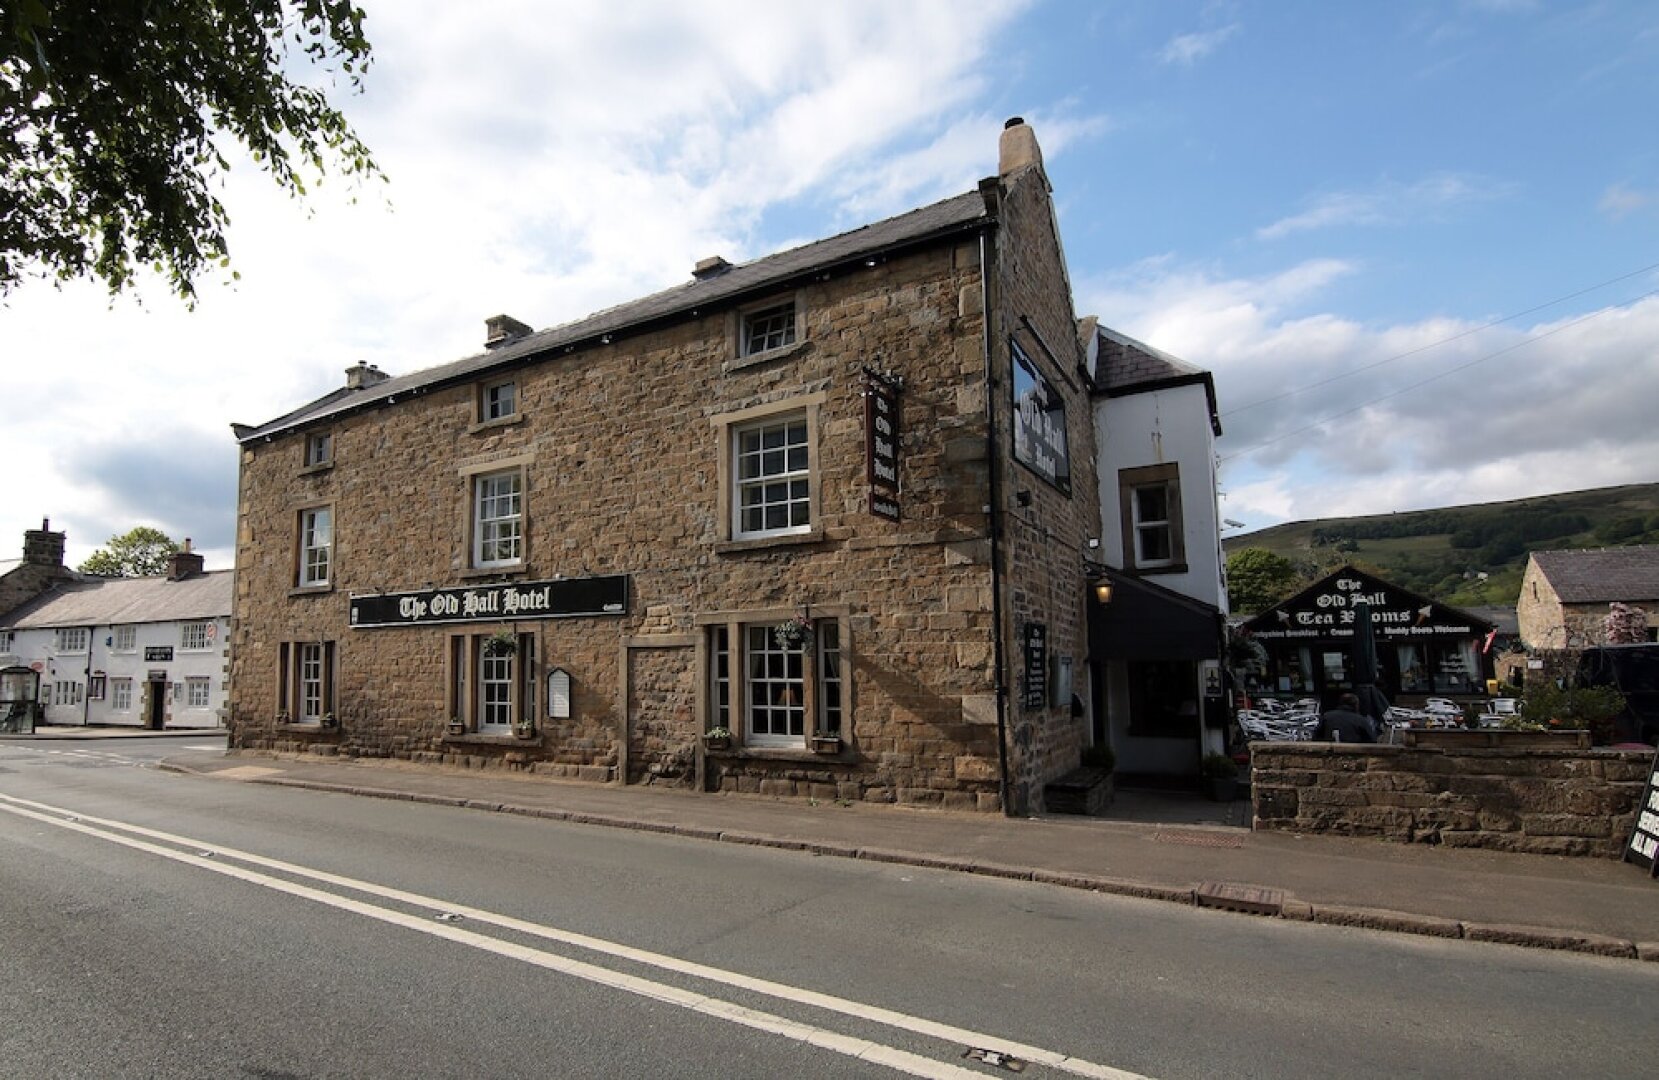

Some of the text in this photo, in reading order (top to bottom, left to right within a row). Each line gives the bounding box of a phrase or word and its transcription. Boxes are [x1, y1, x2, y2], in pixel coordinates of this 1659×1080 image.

[1020, 389, 1042, 434] Old
[1336, 578, 1362, 592] The
[399, 585, 551, 621] The Old Hall Hotel
[1316, 593, 1346, 608] Old
[1296, 609, 1411, 625] Tea Roms
[1384, 626, 1409, 636] Muddy
[1434, 624, 1471, 634] Welcome
